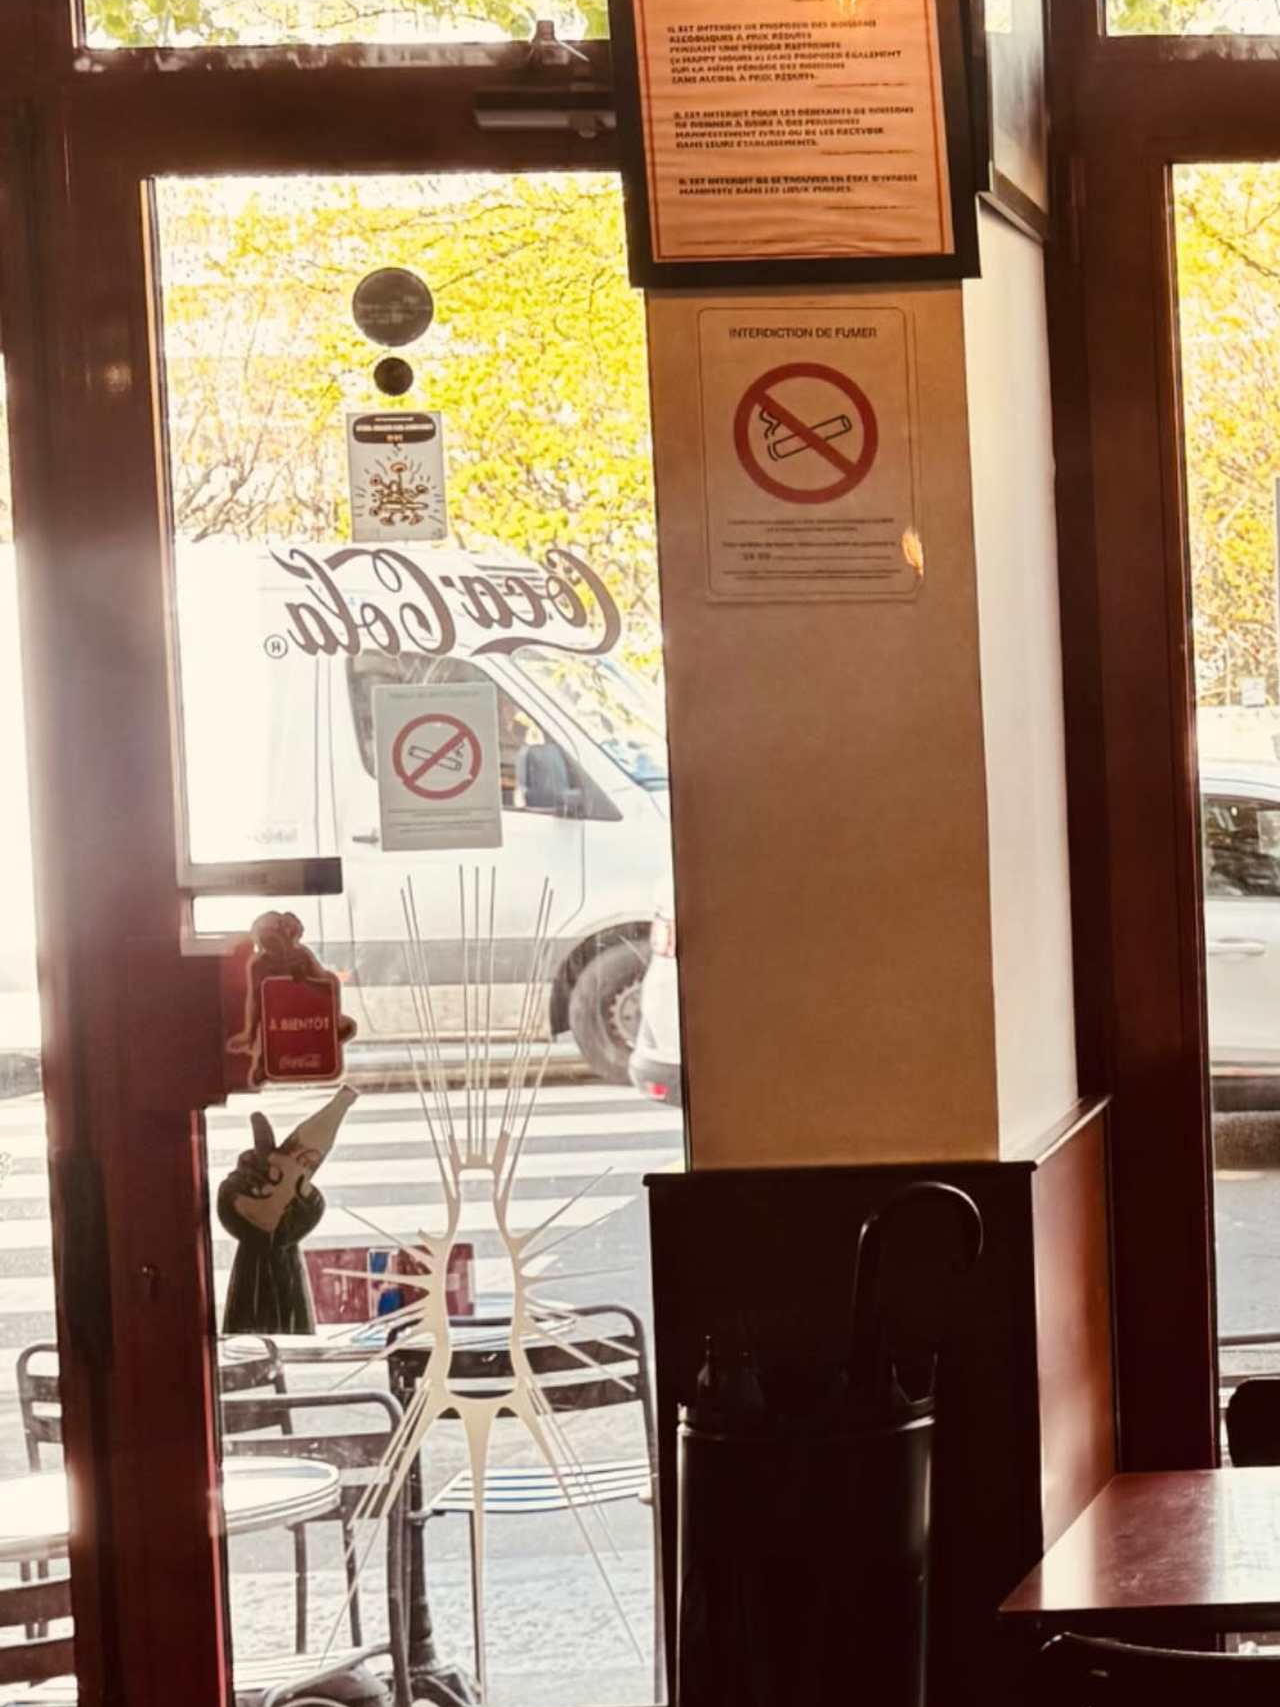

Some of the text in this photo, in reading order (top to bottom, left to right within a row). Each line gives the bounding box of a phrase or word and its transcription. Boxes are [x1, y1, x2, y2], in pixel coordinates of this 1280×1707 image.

[729, 326, 877, 339] INTERDICTION DE FUMER
